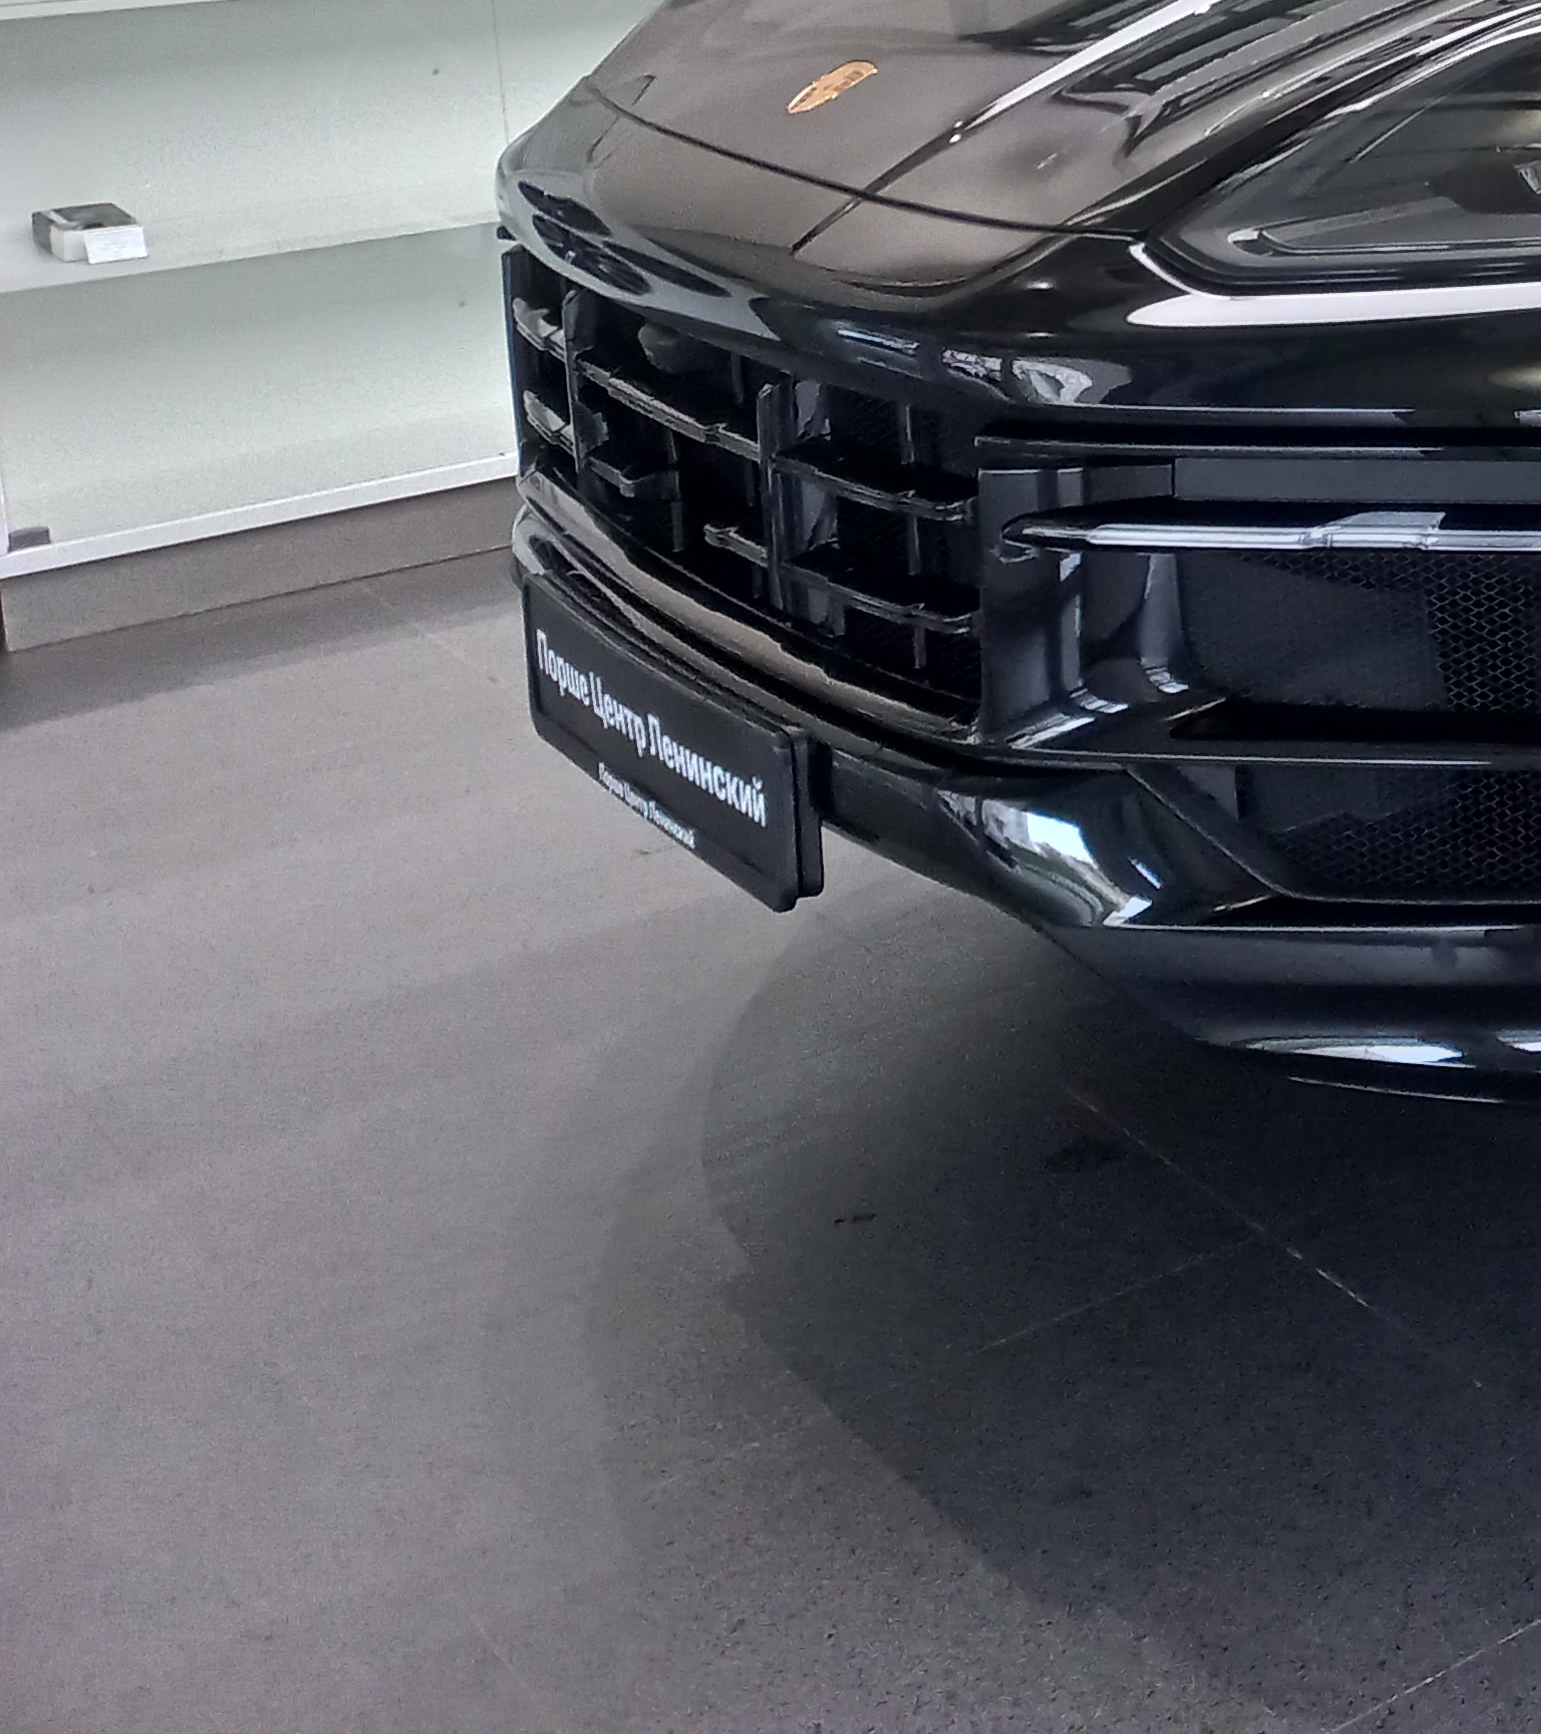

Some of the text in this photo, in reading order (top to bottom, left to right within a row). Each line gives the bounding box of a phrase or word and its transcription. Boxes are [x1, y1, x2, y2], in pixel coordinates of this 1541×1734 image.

[536, 628, 590, 706] Порше
[589, 671, 647, 757] Центр
[647, 713, 767, 828] Ленинский
